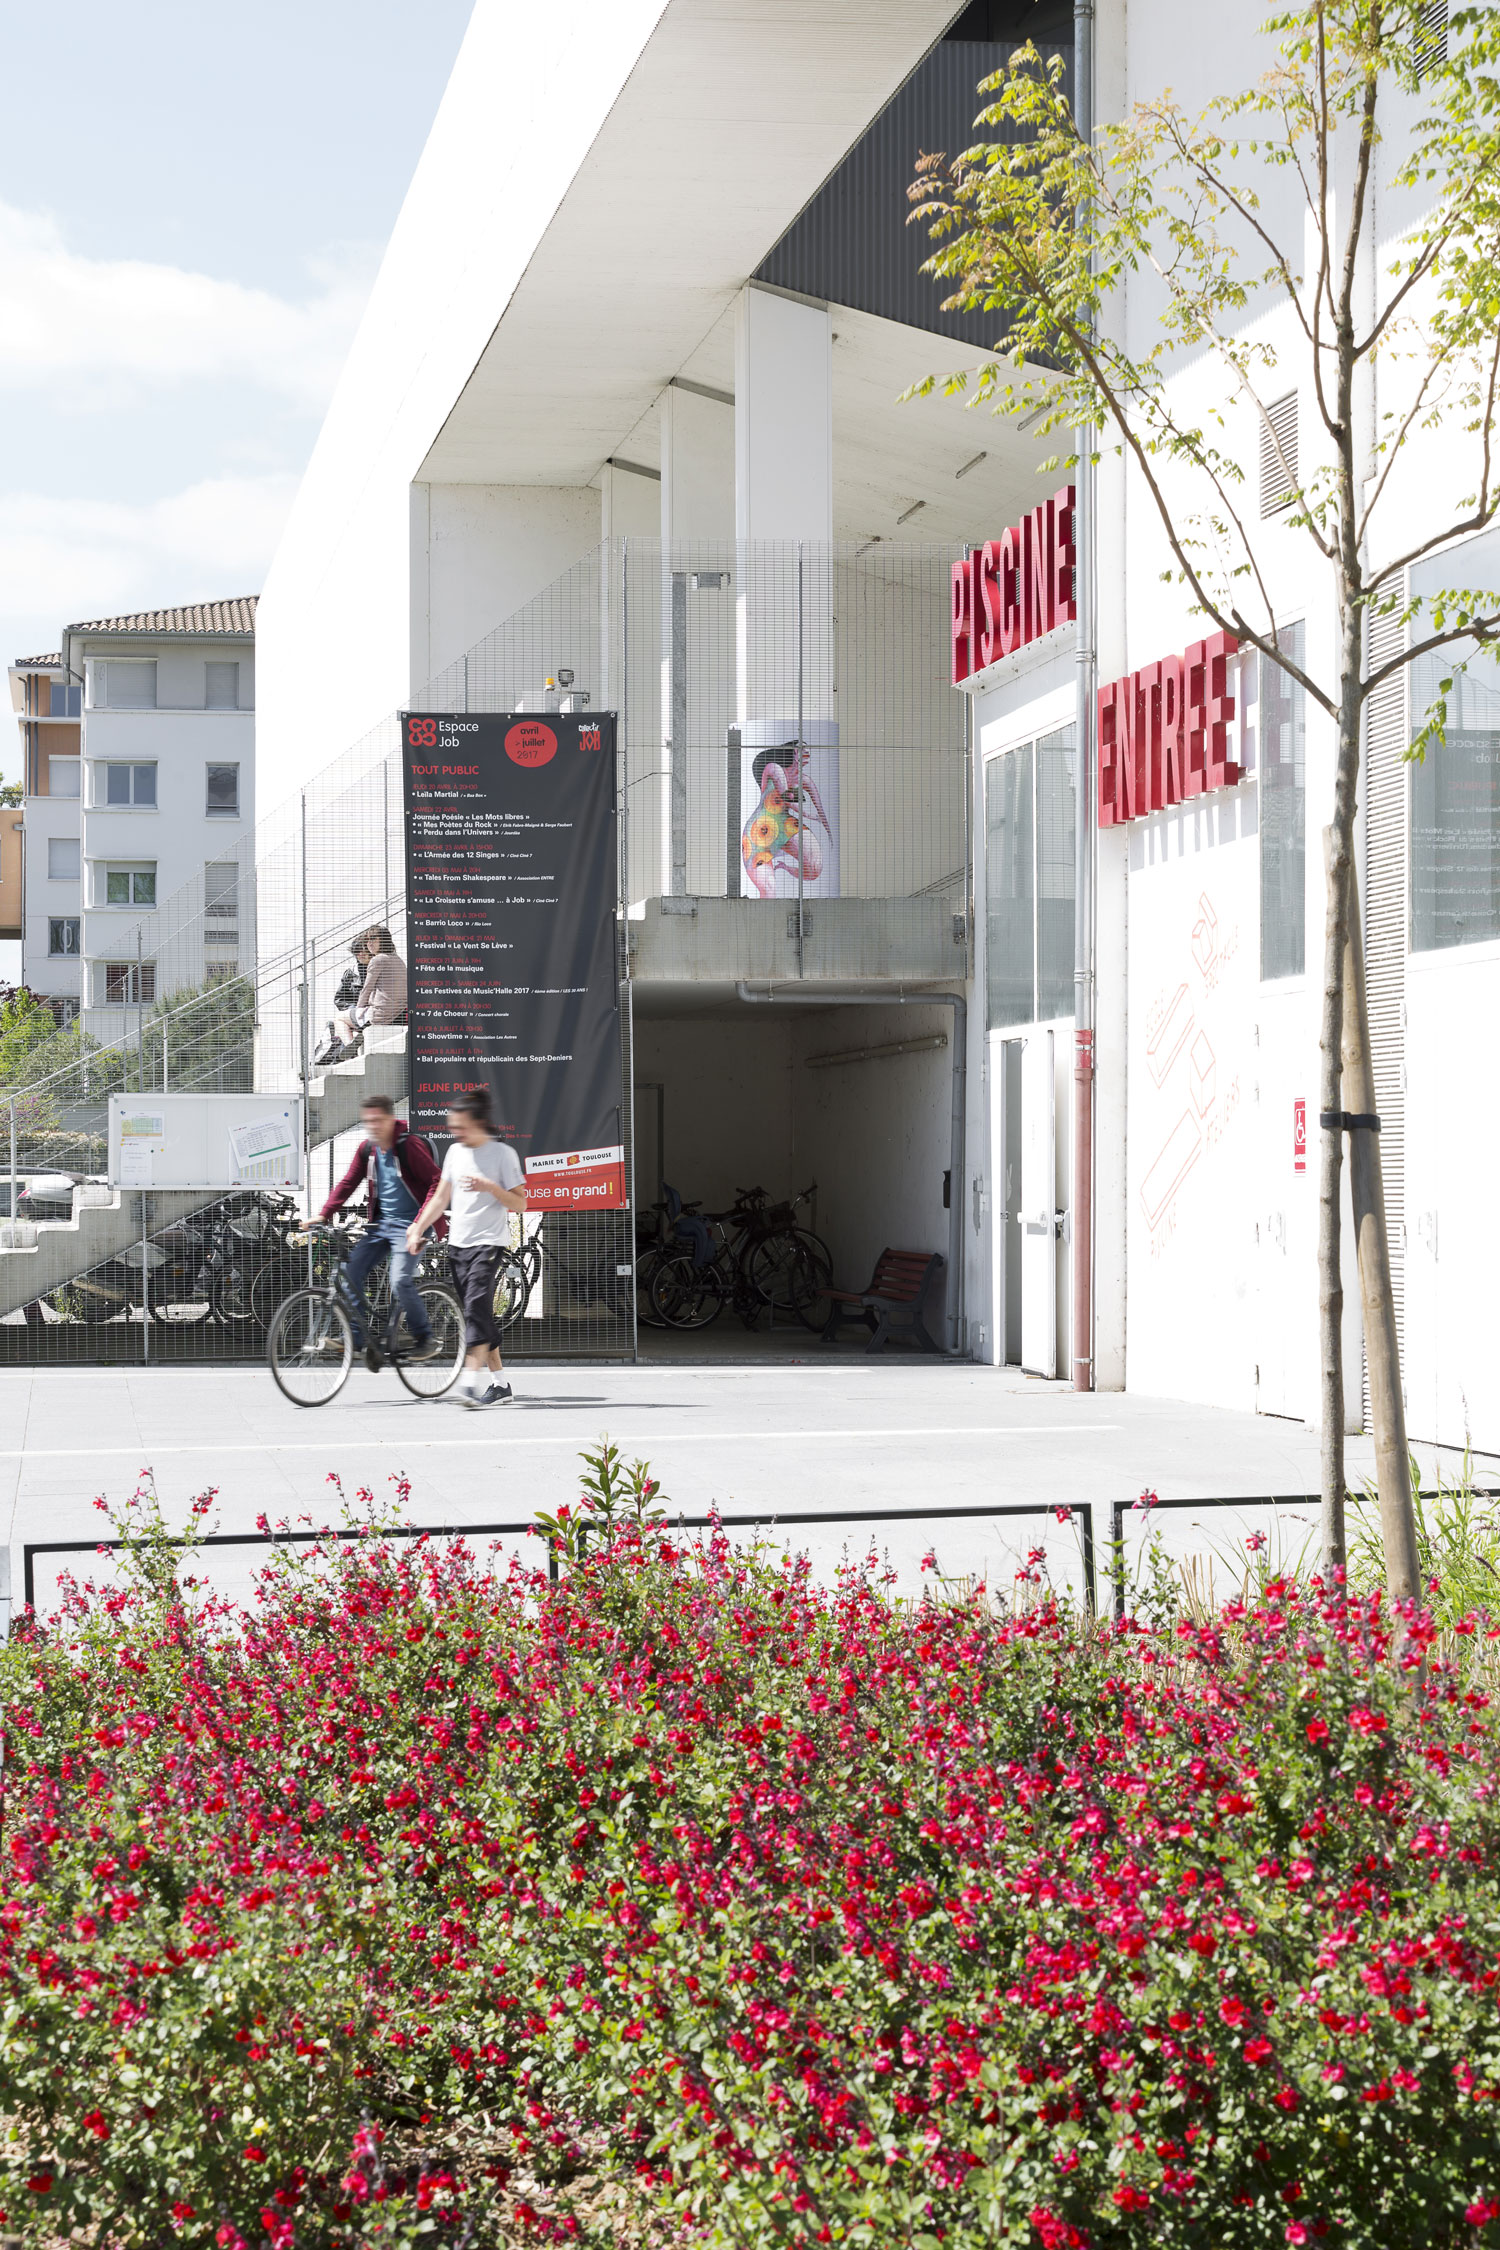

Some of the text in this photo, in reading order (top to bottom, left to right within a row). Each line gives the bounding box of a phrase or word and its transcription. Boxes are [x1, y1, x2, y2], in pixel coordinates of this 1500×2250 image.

[952, 485, 1077, 686] PISCINE
[439, 721, 480, 734] Espace
[520, 727, 539, 735] avril
[1097, 630, 1239, 829] ENTREE
[439, 737, 460, 747] Job
[522, 739, 545, 748] juillet
[579, 730, 601, 751] JOB
[517, 751, 538, 759] 2017
[411, 765, 480, 775] TOUT PUBLIC
[476, 852, 499, 860] Singes
[463, 874, 507, 882] Shakespeare
[455, 965, 484, 973] musique
[529, 1055, 573, 1063] Sept-Deniers
[417, 1083, 450, 1092] JEUNE
[532, 1160, 554, 1168] MAIRIE
[582, 1152, 612, 1161] TOULOUSE
[524, 1182, 613, 1200] ouse en grand !
